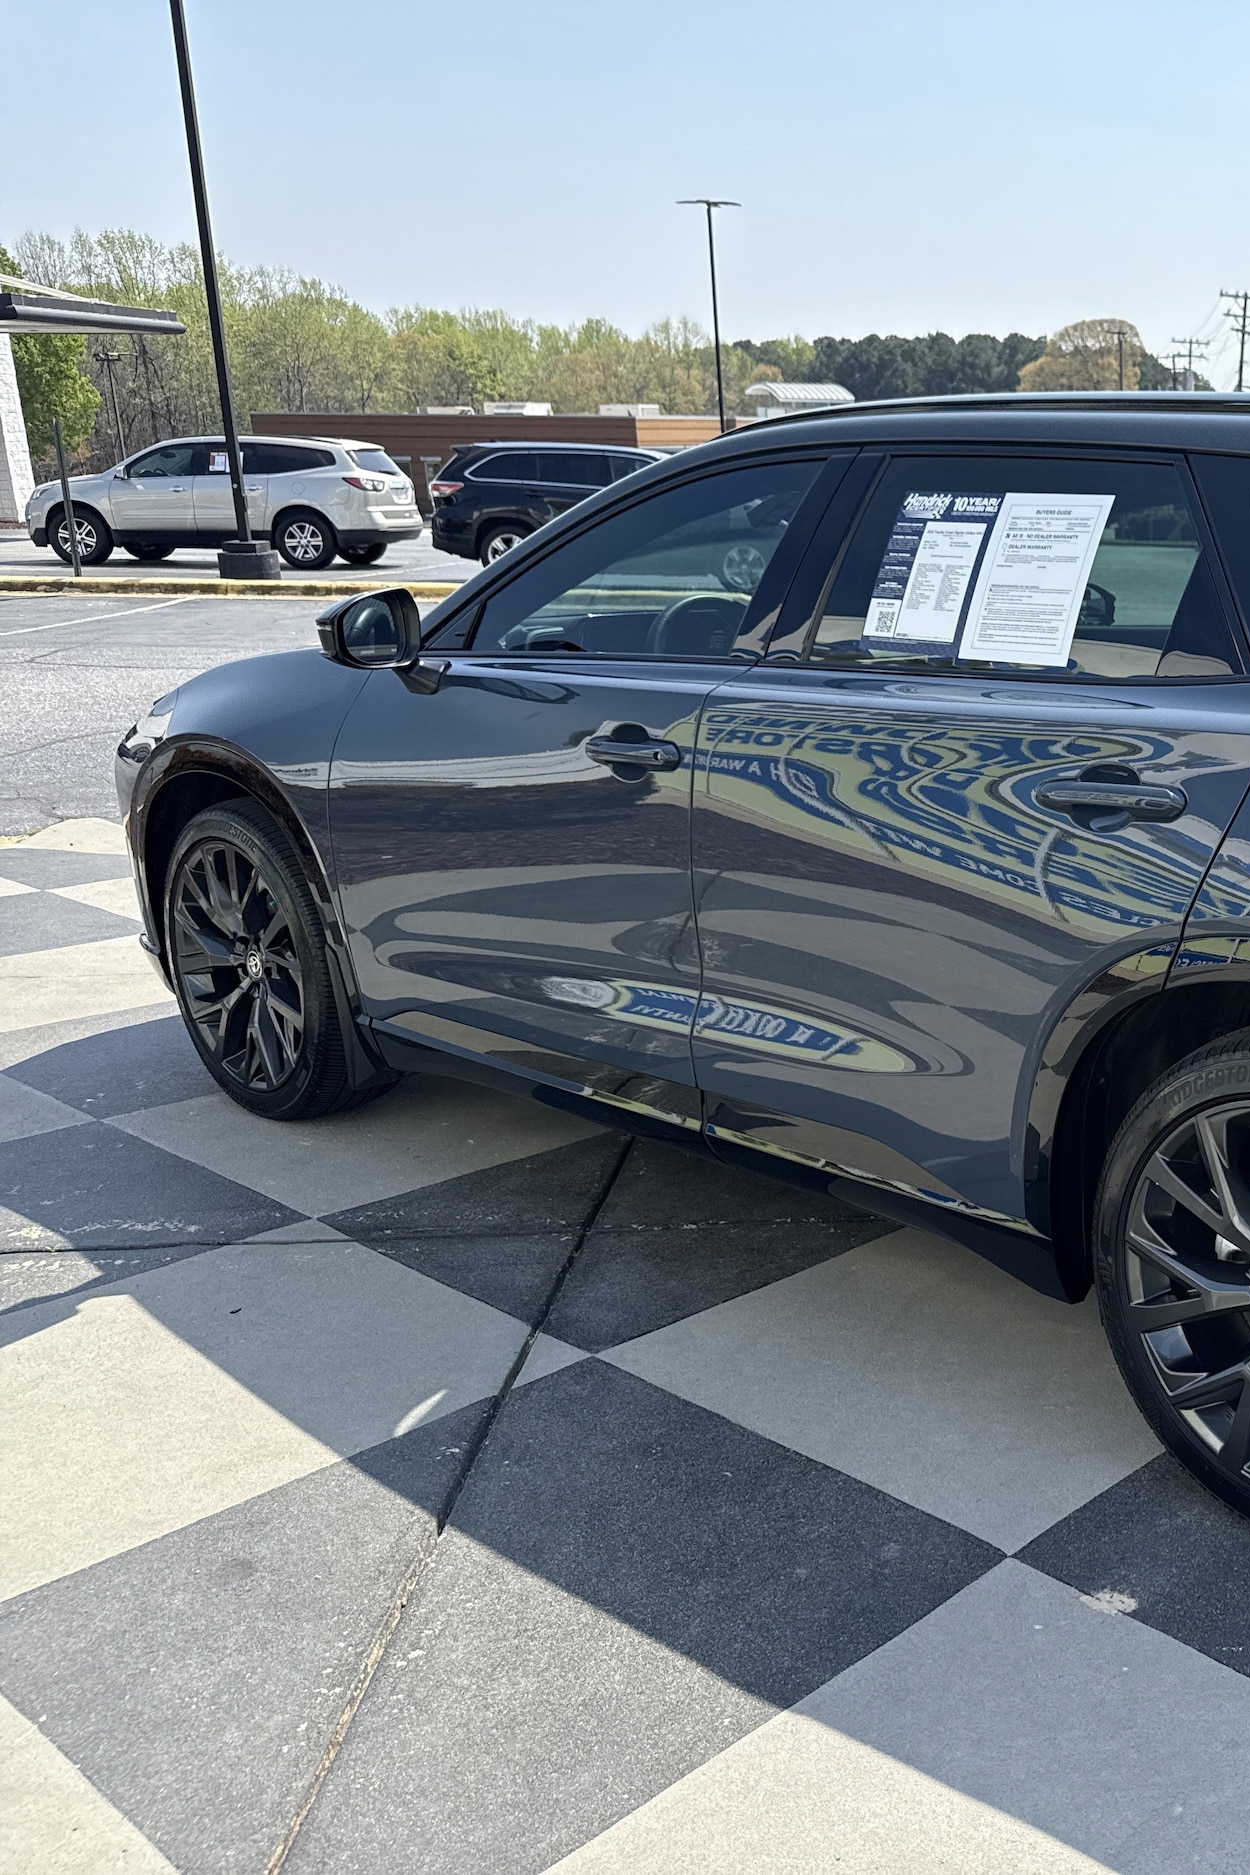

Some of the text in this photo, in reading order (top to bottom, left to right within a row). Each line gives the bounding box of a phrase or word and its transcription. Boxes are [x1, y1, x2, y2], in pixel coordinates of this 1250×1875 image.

[903, 493, 953, 511] Hendrick
[953, 496, 1001, 512] 10 YEAR/
